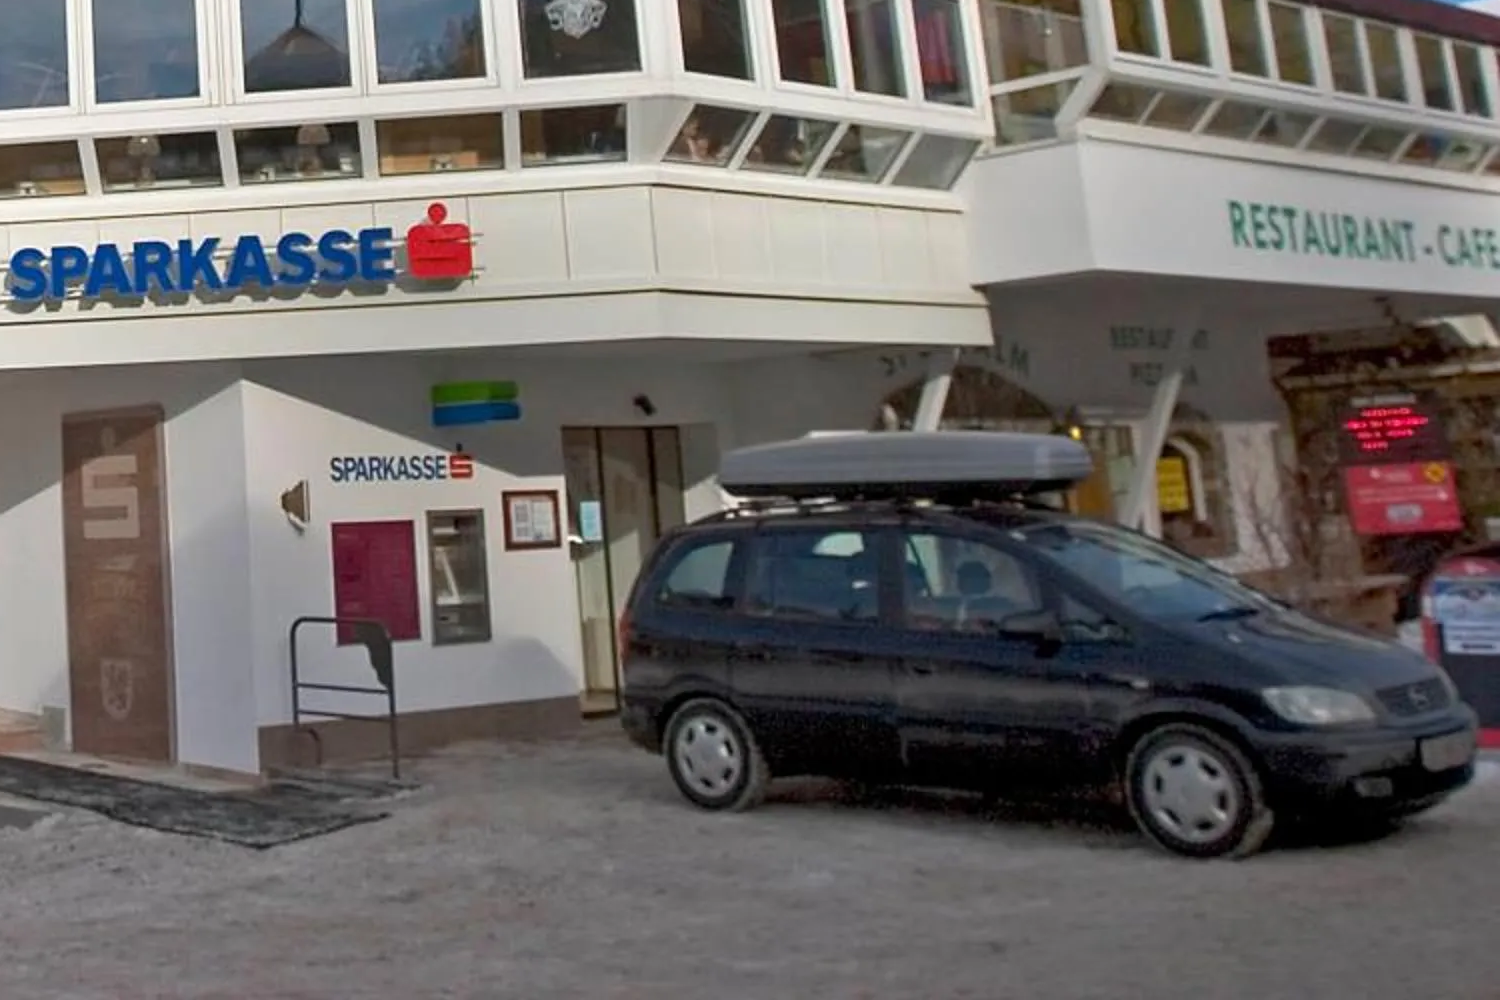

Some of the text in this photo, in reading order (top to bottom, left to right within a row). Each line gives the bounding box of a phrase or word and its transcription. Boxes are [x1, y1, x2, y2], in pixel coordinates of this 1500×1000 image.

[8, 226, 396, 300] SPARKASSE
[1228, 200, 1416, 263] RESTAURANT
[329, 454, 447, 483] SPARKASSE
